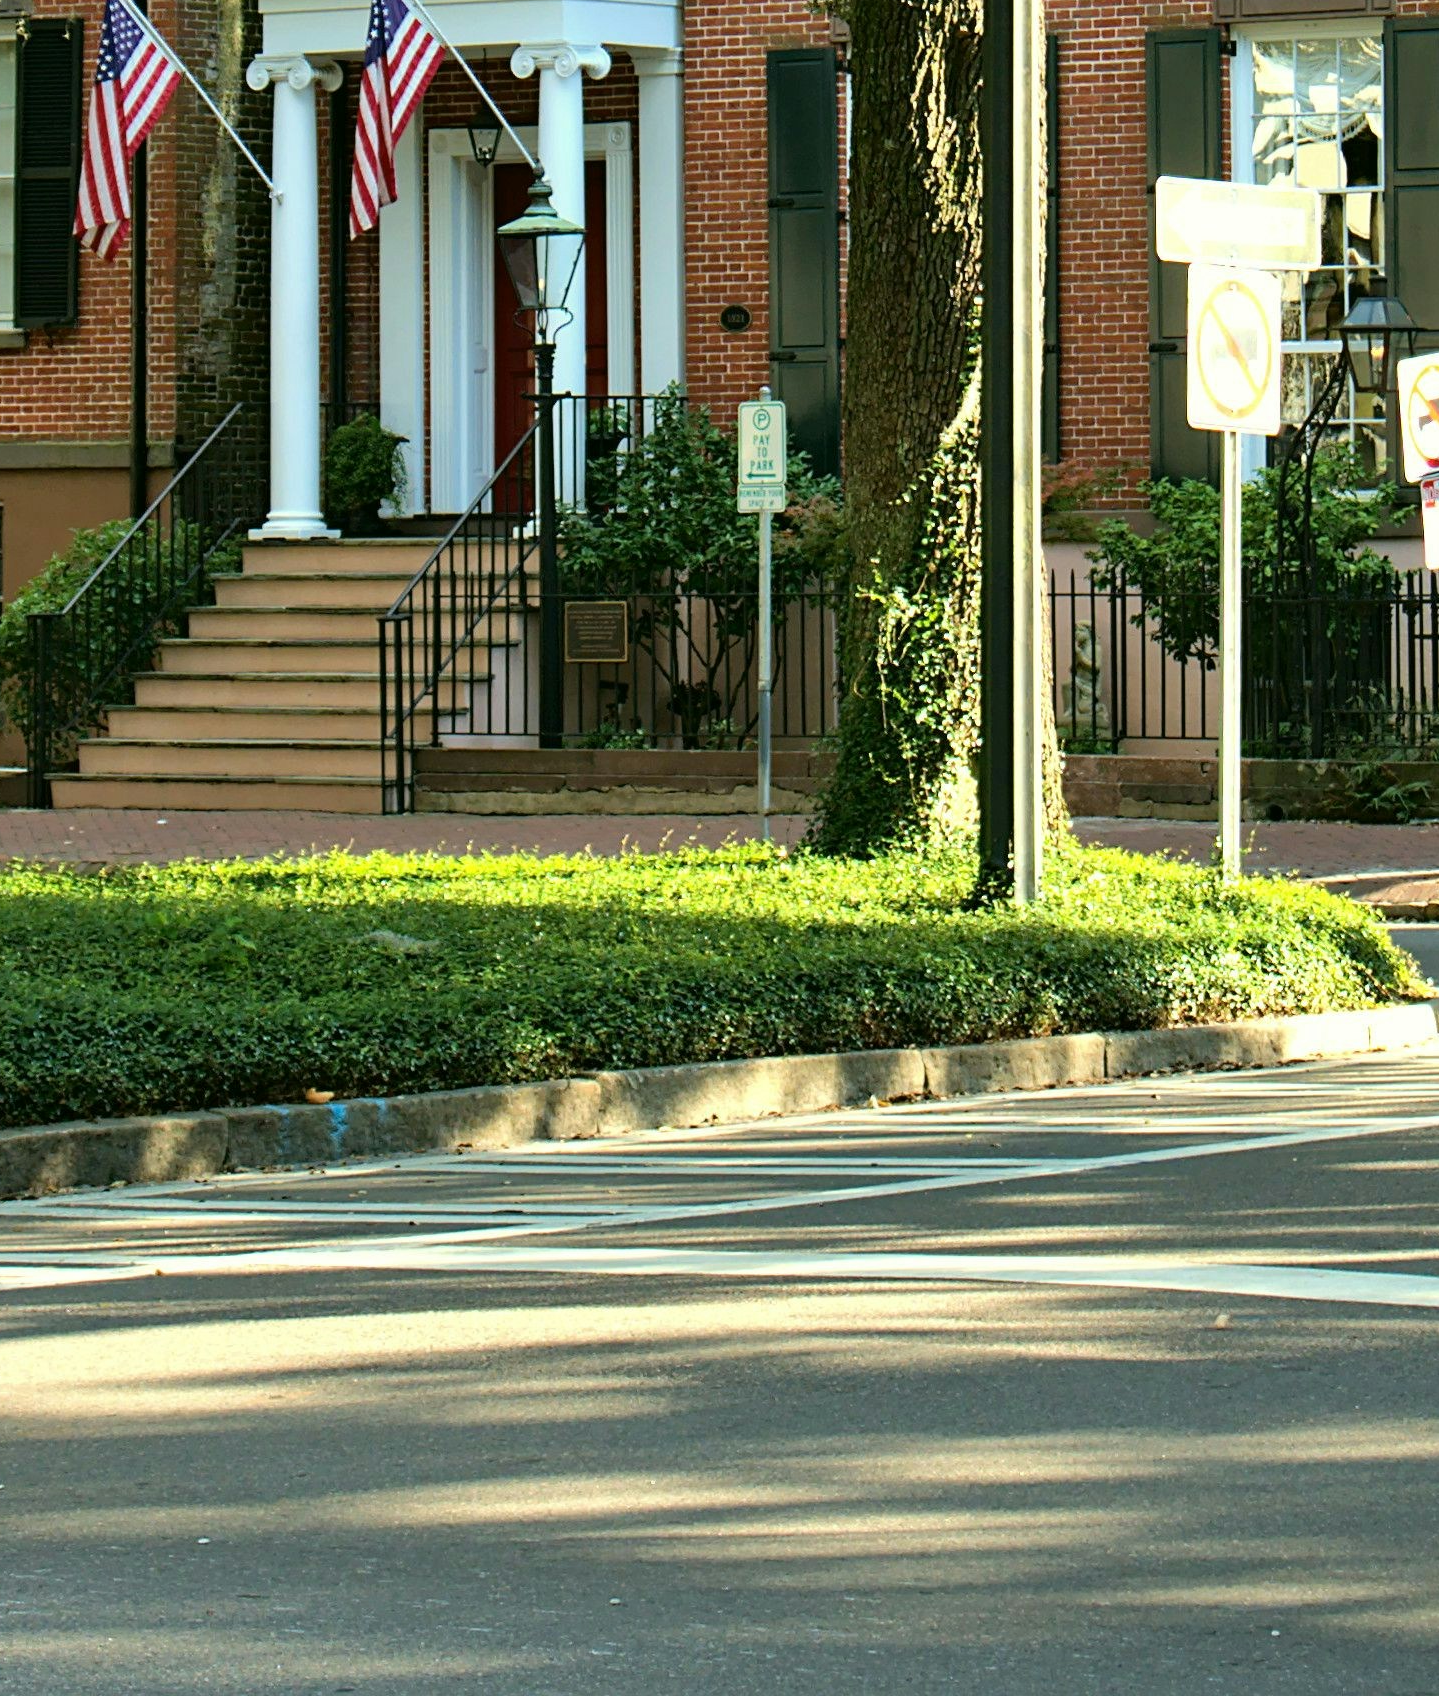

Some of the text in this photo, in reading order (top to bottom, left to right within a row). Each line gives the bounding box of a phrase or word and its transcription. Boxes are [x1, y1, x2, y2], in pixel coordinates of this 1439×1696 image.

[757, 413, 767, 425] P
[753, 435, 770, 445] PAY
[757, 447, 768, 458] TO
[750, 460, 774, 471] PARK
